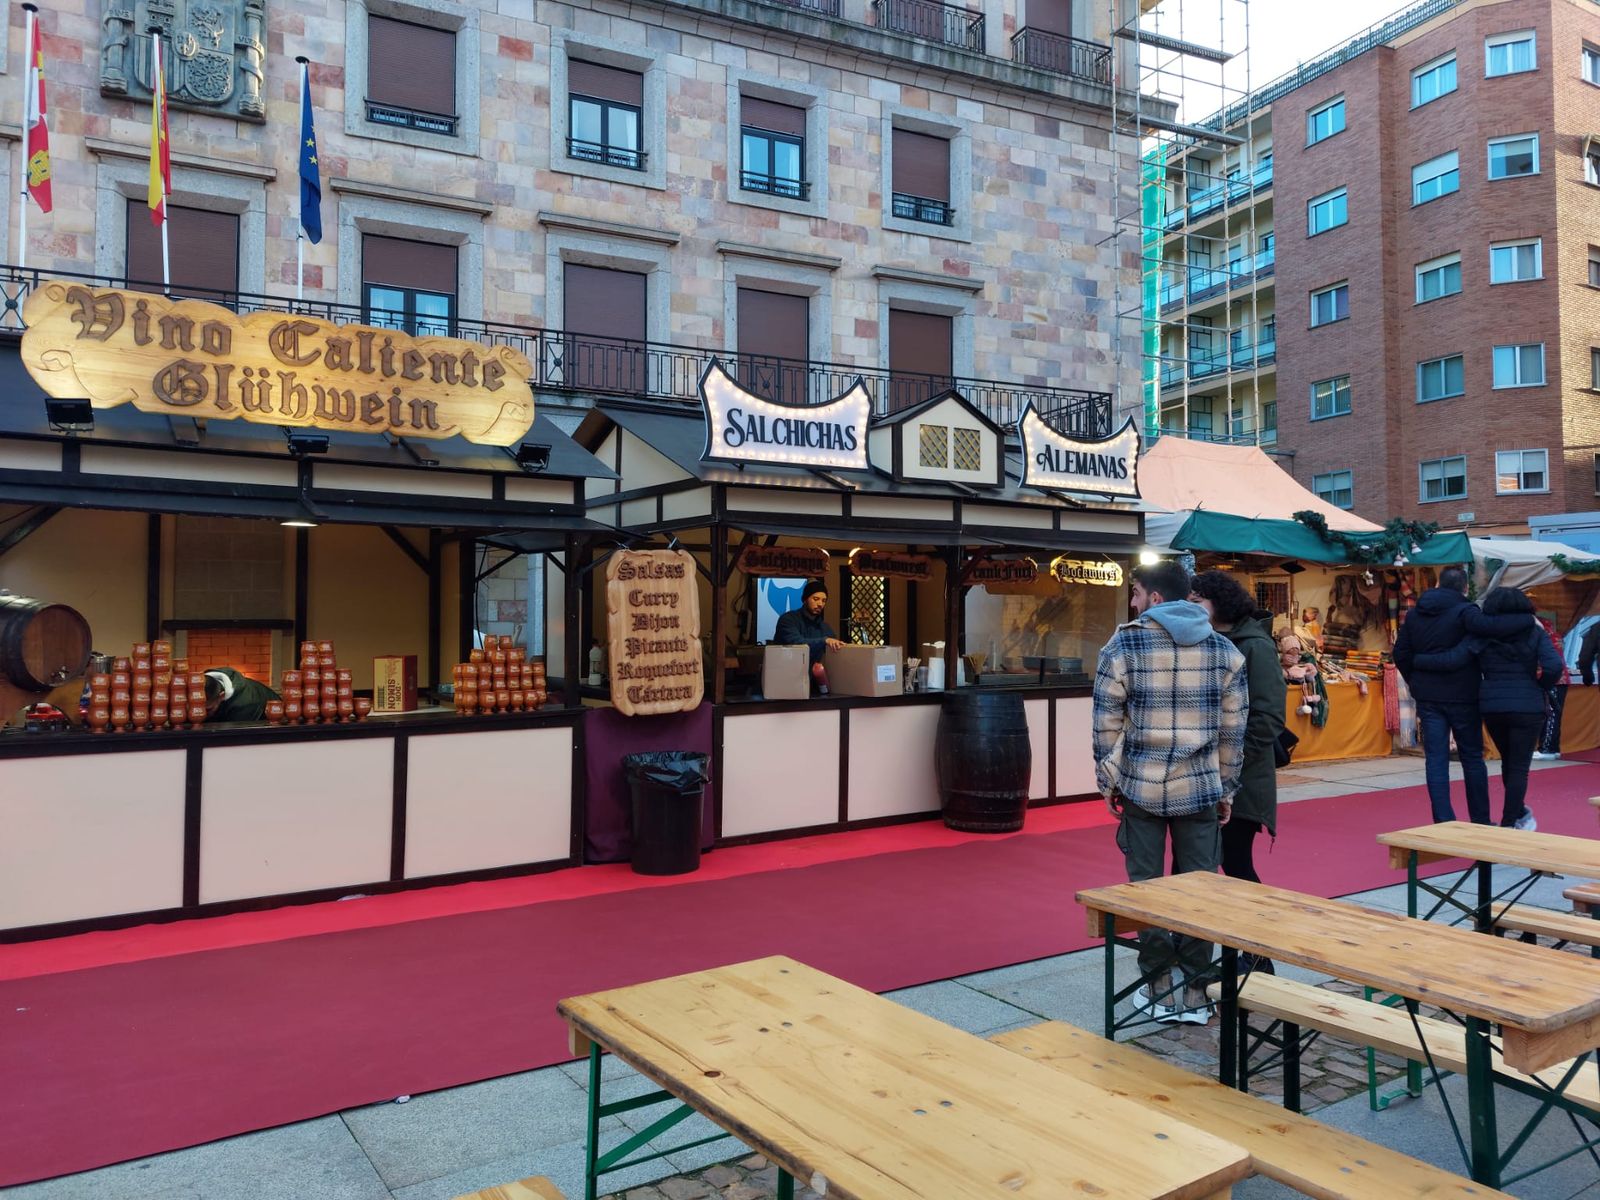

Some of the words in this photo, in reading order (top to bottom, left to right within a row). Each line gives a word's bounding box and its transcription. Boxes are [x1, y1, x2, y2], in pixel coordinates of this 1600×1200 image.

[67, 286, 232, 354] Vino
[268, 319, 507, 392] Caliente
[152, 359, 440, 430] Glühwein
[723, 408, 857, 452] SALCHICHAS
[1035, 443, 1128, 481] ALEMANAS
[617, 560, 685, 581] Salsas
[1057, 563, 1119, 581] Bockwurs
[628, 589, 680, 608] Curry
[632, 613, 680, 633] Dijon
[625, 637, 689, 658] Picante
[617, 660, 700, 681] Roquefort
[387, 679, 396, 710] SIMON
